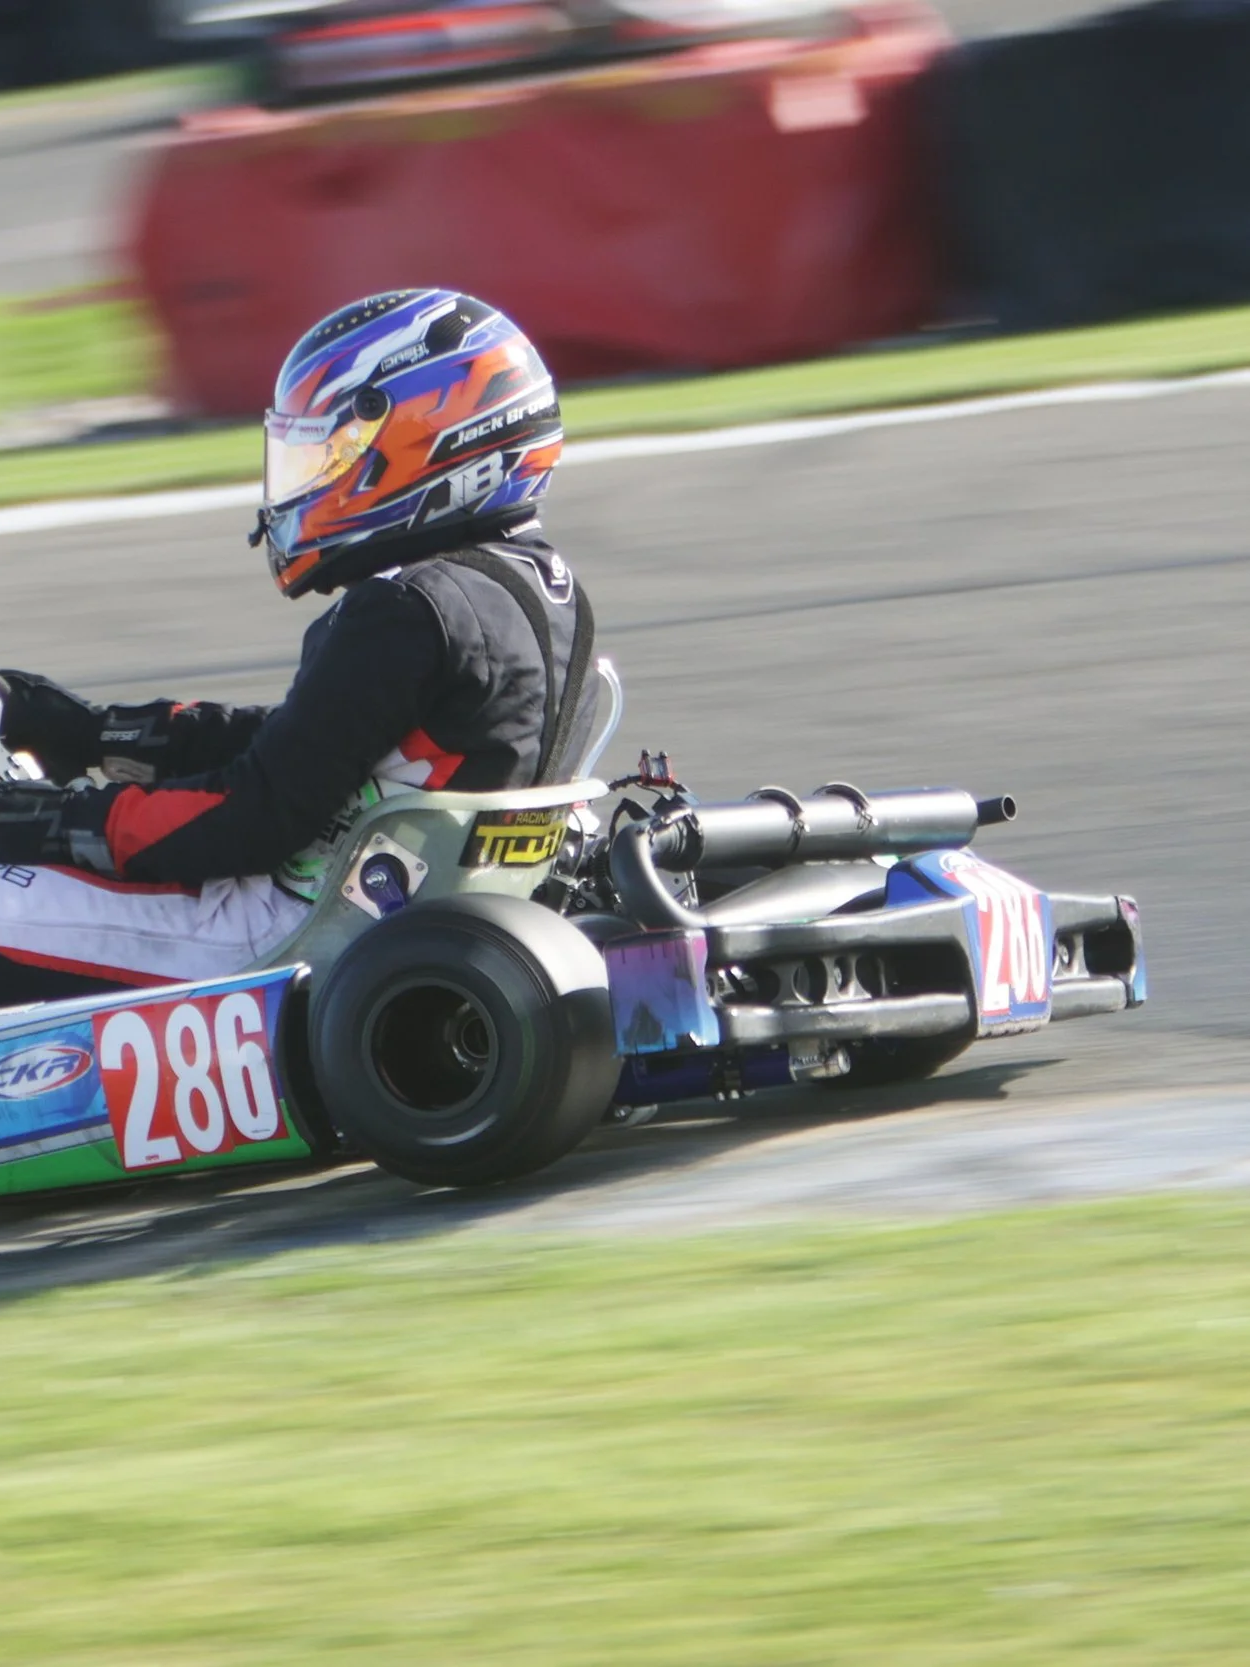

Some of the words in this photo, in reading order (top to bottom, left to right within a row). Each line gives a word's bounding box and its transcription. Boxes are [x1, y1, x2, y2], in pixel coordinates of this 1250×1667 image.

[450, 415, 503, 450] Jack
[423, 450, 503, 524] JB
[954, 869, 1046, 1012] 286
[100, 992, 279, 1168] 286
